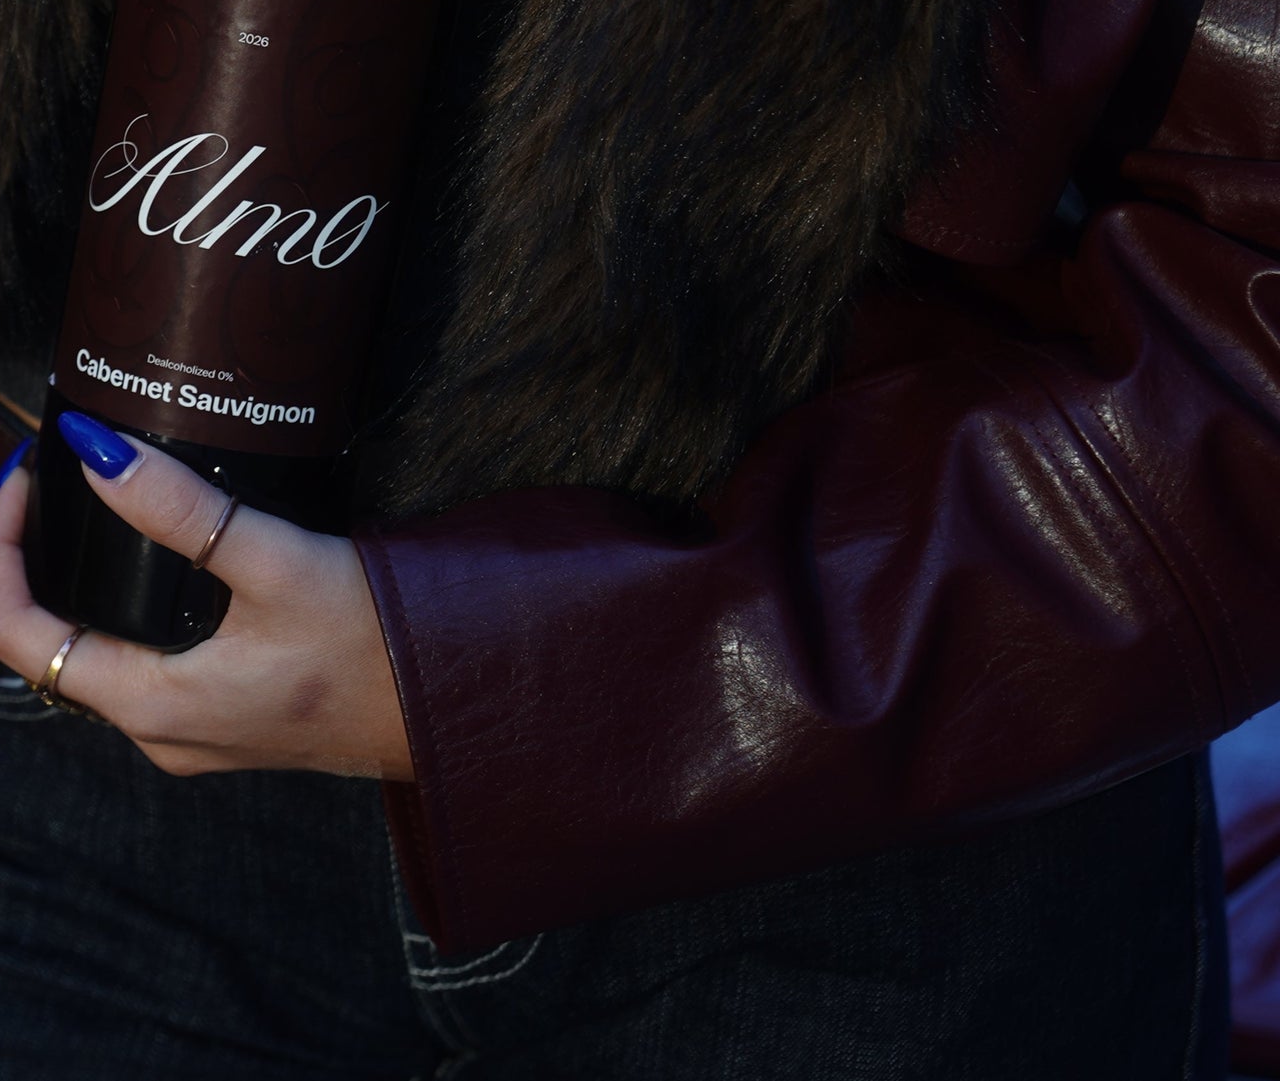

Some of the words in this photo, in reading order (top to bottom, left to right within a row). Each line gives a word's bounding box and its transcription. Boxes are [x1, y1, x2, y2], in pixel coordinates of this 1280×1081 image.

[238, 31, 270, 48] 2026
[146, 353, 217, 380] Dealcoholized
[217, 370, 235, 383] 0%
[75, 347, 174, 404] Cabernet
[177, 383, 317, 427] Sauvignon
